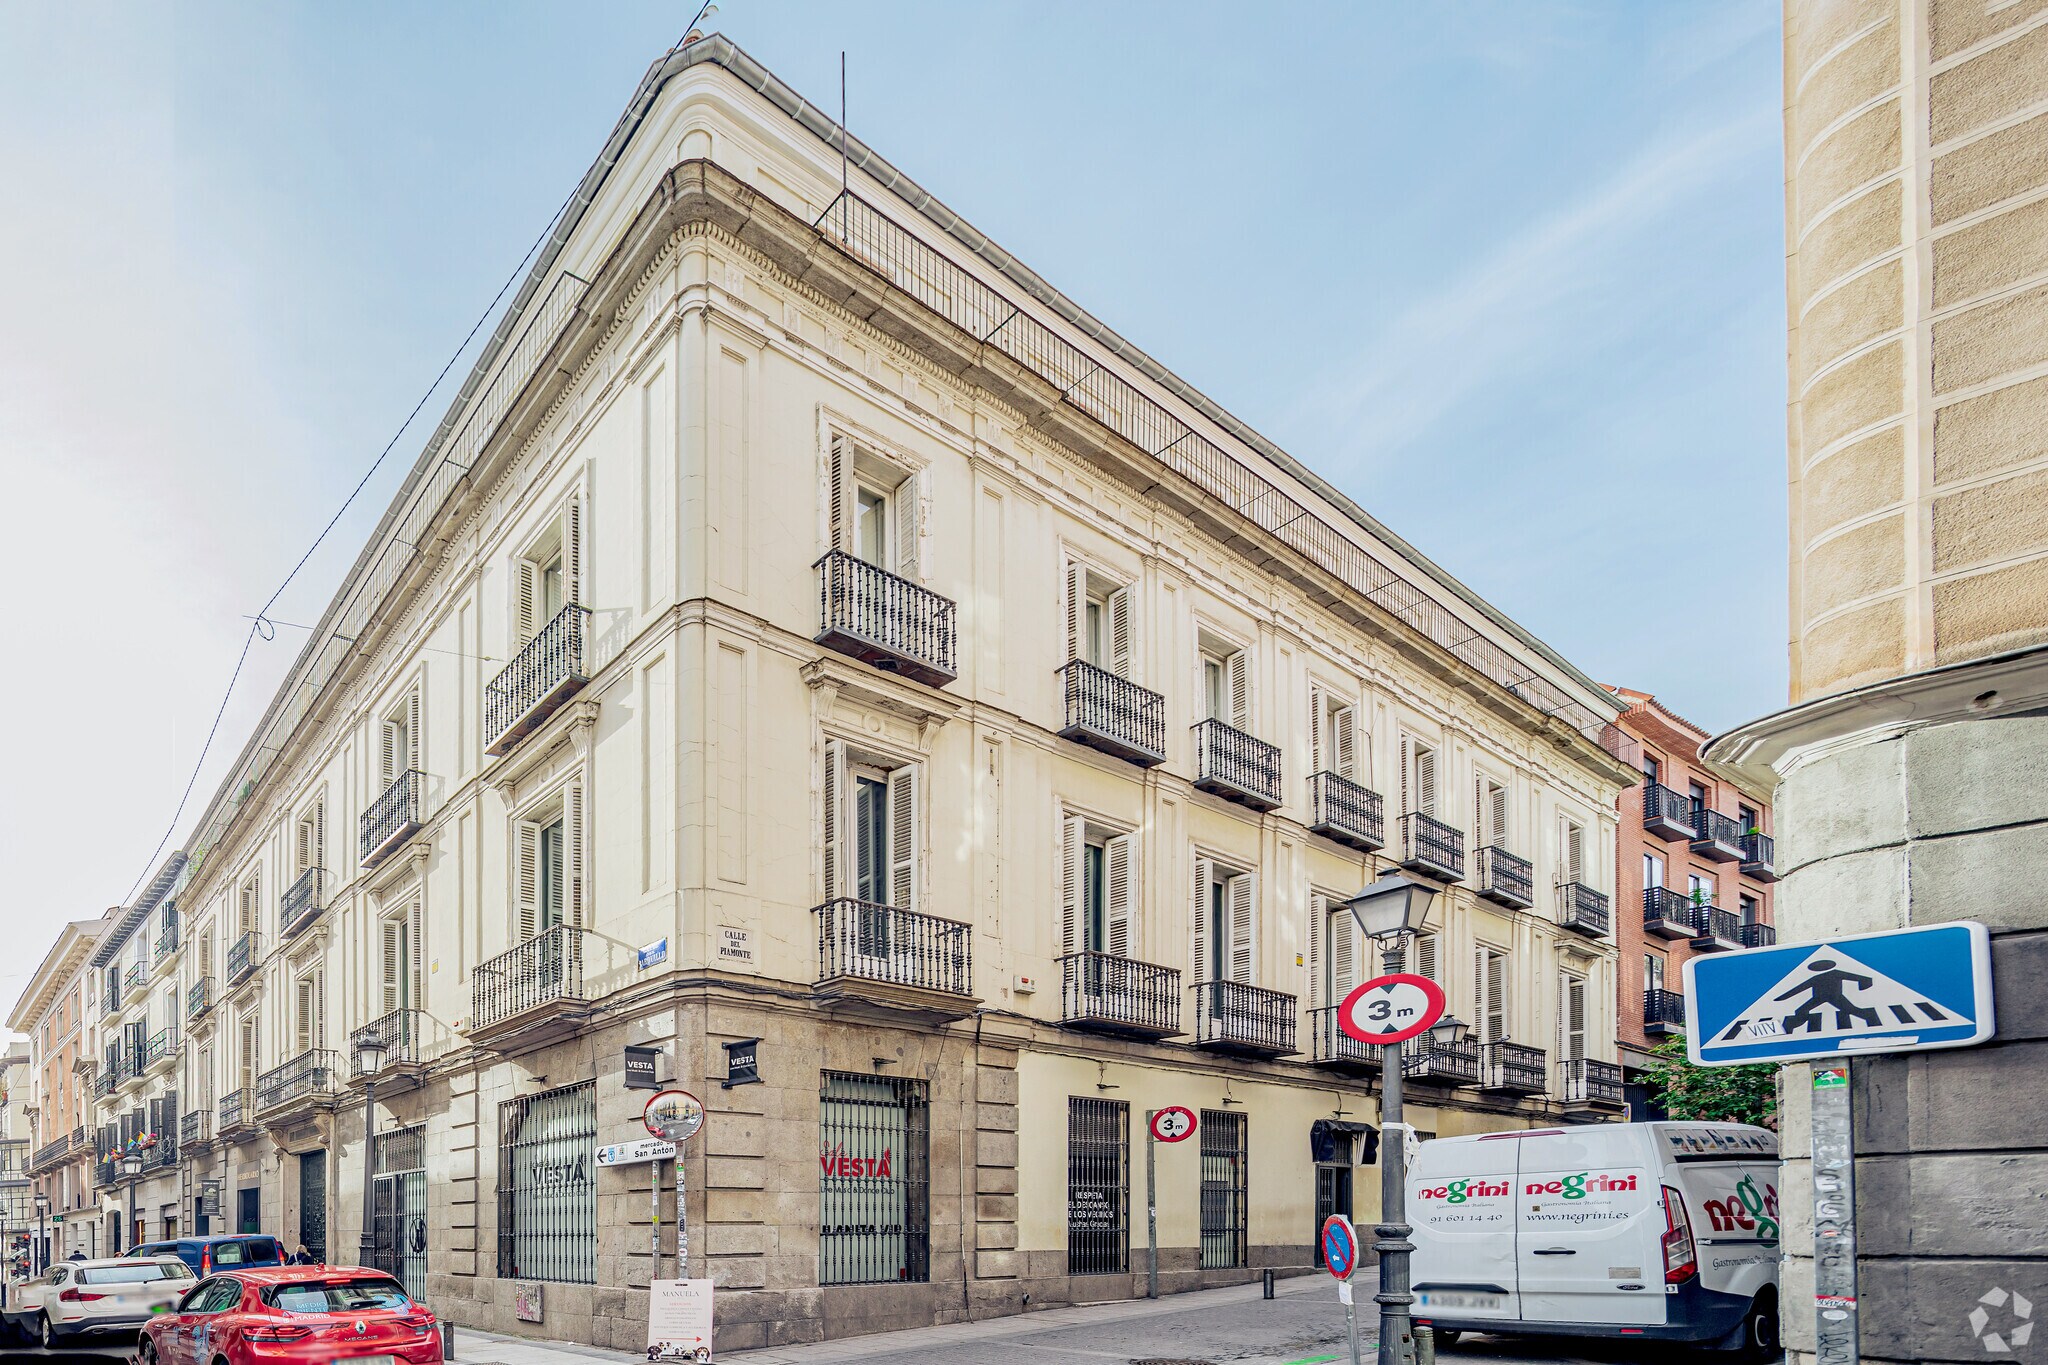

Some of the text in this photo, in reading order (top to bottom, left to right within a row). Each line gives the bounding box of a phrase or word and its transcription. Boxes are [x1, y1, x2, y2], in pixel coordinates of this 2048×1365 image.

[725, 931, 746, 941] CALLE
[720, 947, 751, 959] PIAMONTE
[1368, 1000, 1414, 1021] 3 m
[627, 1060, 653, 1070] VESTA
[731, 1055, 754, 1066] VESTA
[1164, 1120, 1174, 1130] 3
[640, 1141, 663, 1149] mercado
[634, 1145, 674, 1158] San Antón
[820, 1157, 891, 1178] VESTA
[532, 1164, 585, 1184] VESTA
[821, 1186, 895, 1195] Live Music & Dance Club
[1418, 1178, 1510, 1203] negrini
[1525, 1172, 1637, 1199] negrini
[1075, 1191, 1103, 1199] RESPETA
[1429, 1216, 1442, 1224] 91
[1446, 1214, 1464, 1222] 601
[1526, 1210, 1629, 1224] www.negrini.es
[296, 1301, 327, 1309] MEDIO
[295, 1313, 331, 1322] MADRID
